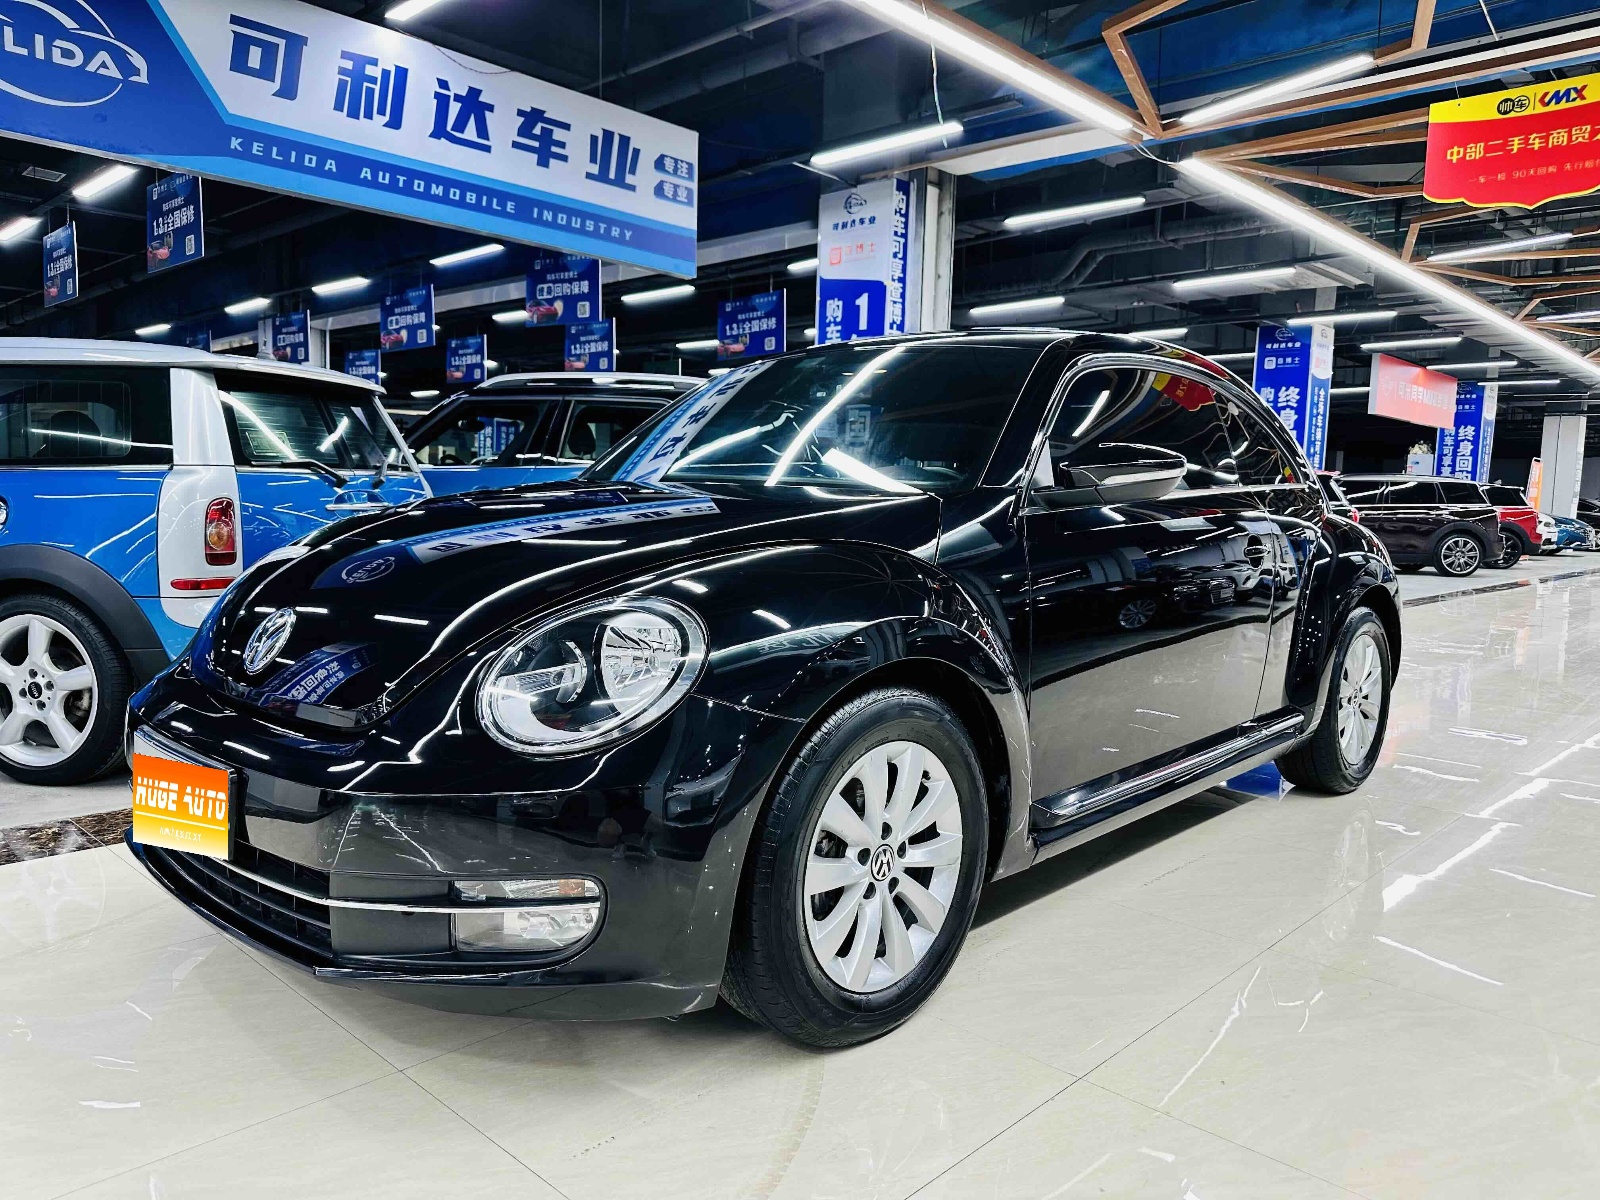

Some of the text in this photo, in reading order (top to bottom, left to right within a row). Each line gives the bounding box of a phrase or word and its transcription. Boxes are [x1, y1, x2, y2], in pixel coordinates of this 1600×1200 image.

[229, 13, 641, 192] 可利达车业
[230, 136, 635, 241] KELIDA AUTOMOBILE INDUSTRY
[663, 156, 689, 178] 专注
[663, 182, 688, 203] 专业
[1454, 425, 1476, 480] 终身回购
